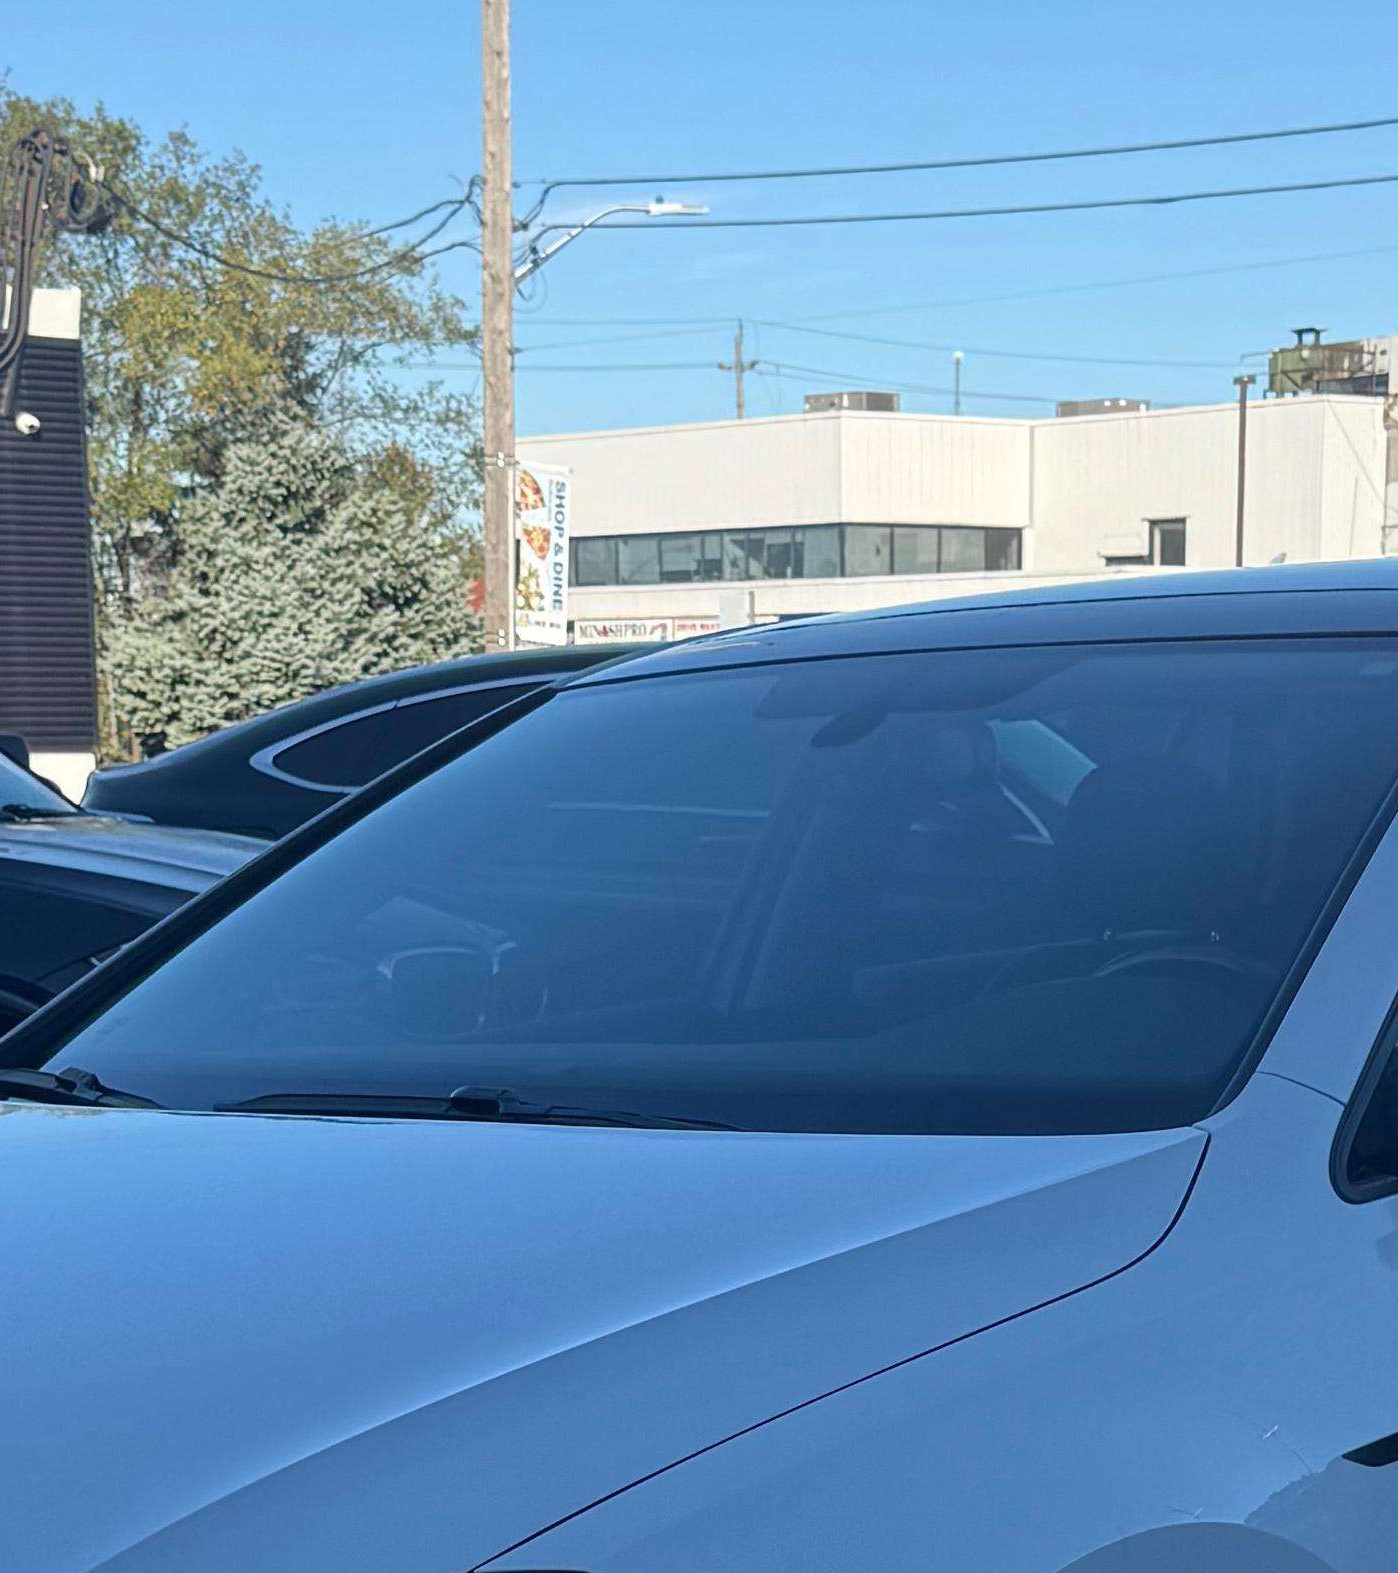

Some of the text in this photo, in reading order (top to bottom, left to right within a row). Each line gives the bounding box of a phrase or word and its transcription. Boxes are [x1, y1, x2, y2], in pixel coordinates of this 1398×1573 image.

[553, 480, 566, 612] SHOP & DINE
